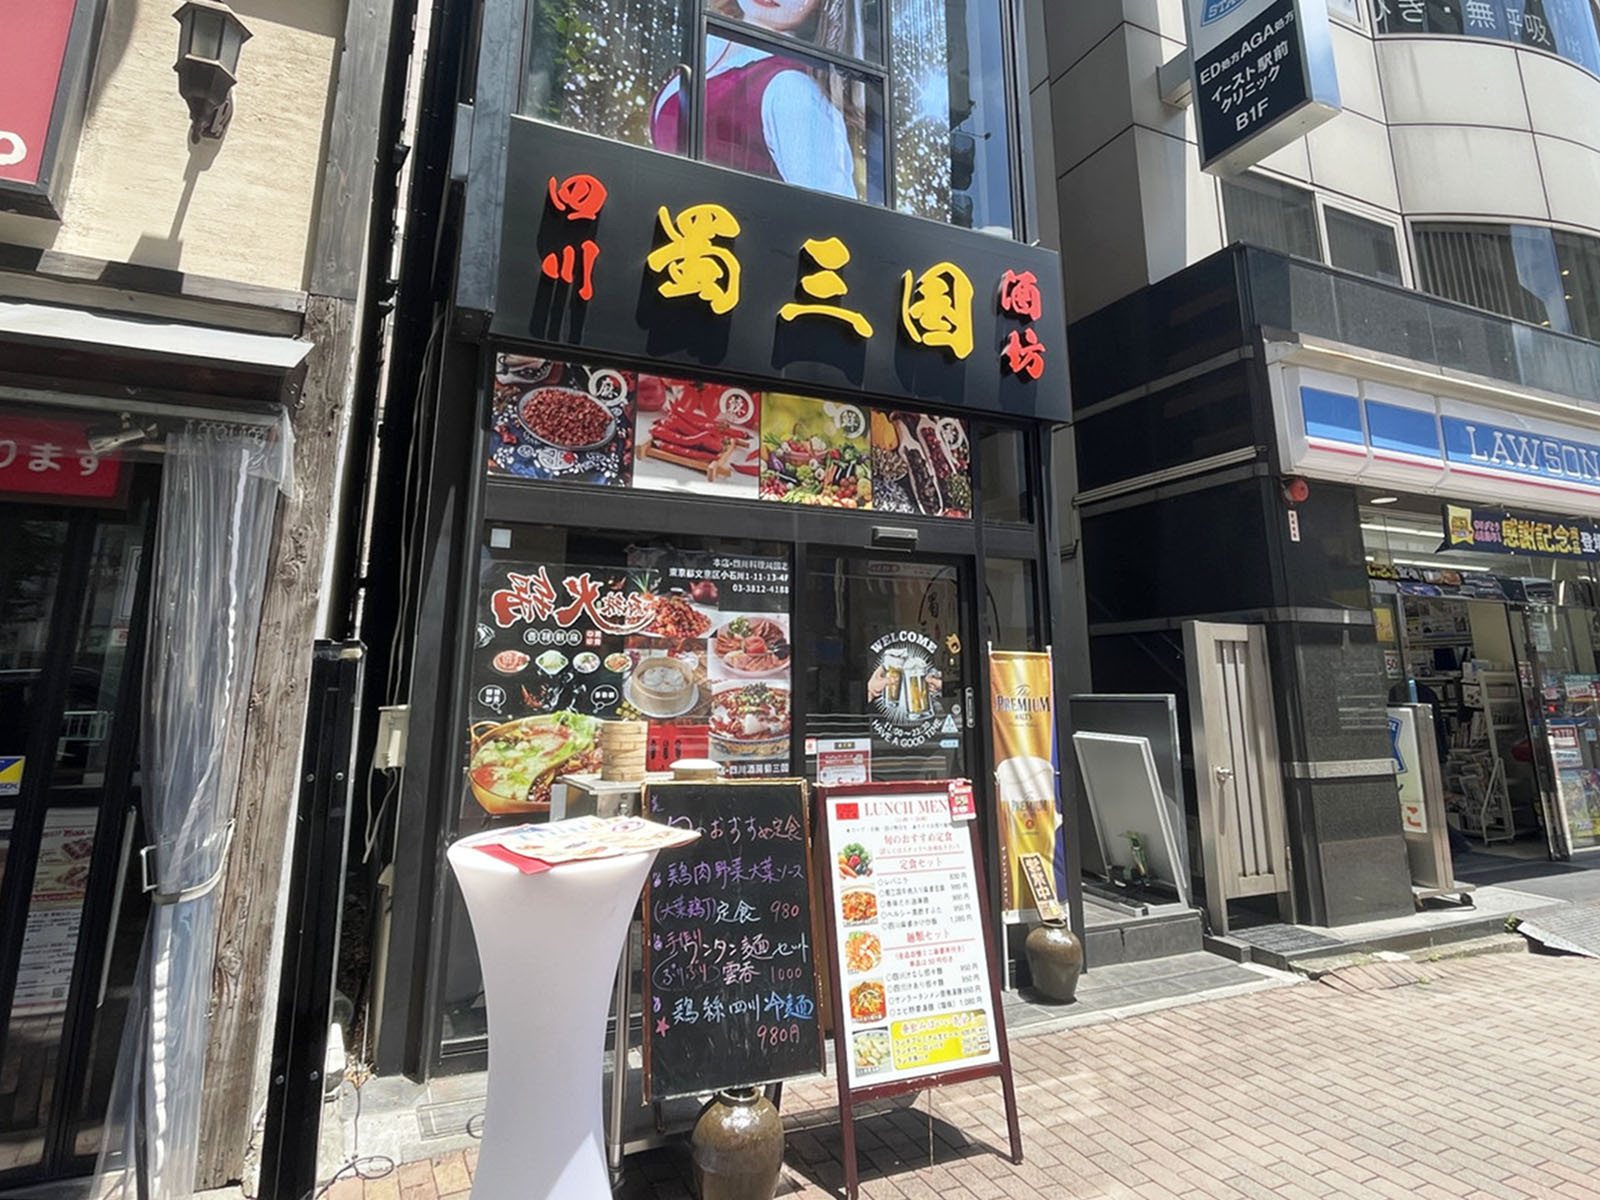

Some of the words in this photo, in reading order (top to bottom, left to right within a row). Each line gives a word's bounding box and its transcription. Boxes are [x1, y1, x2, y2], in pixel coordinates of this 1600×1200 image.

[1211, 40, 1289, 102] イースト駅前
[1220, 65, 1281, 114] クリニック
[1236, 97, 1269, 131] B1F
[541, 174, 608, 301] 四川
[1465, 425, 1600, 481] LAWSON
[870, 630, 938, 655] WELCOME
[996, 694, 1050, 712] PREMIUM
[872, 719, 892, 743] HAVE
[891, 736, 899, 746] A
[900, 735, 926, 748] GOOD
[925, 717, 944, 739] TIME
[864, 801, 914, 817] LUNCH
[918, 798, 948, 815] MEN
[900, 858, 943, 870] 定食セット
[770, 900, 800, 923] 980
[907, 930, 950, 943] 麺類セット
[771, 966, 802, 983] 1000
[757, 1024, 800, 1050] 980円
